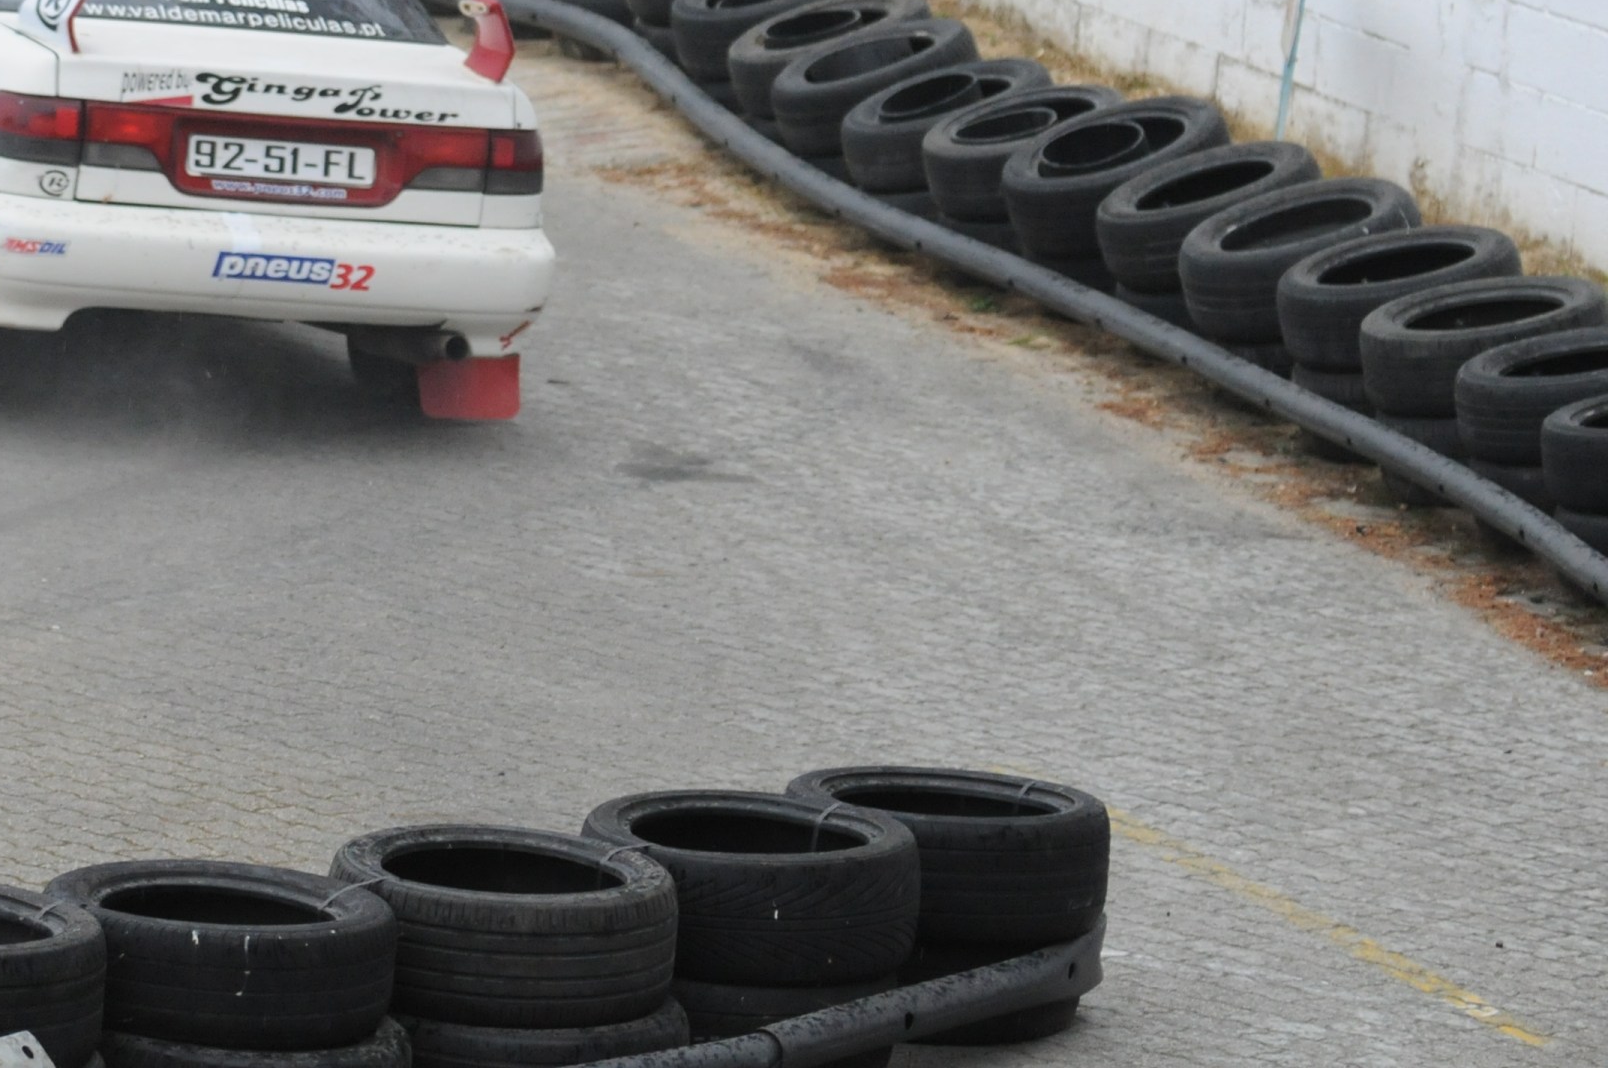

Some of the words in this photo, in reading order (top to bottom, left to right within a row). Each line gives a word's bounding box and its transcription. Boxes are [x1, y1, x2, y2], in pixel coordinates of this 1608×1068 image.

[195, 71, 341, 105] Ginga
[333, 83, 459, 124] Power
[193, 138, 367, 181] 92-51-FL
